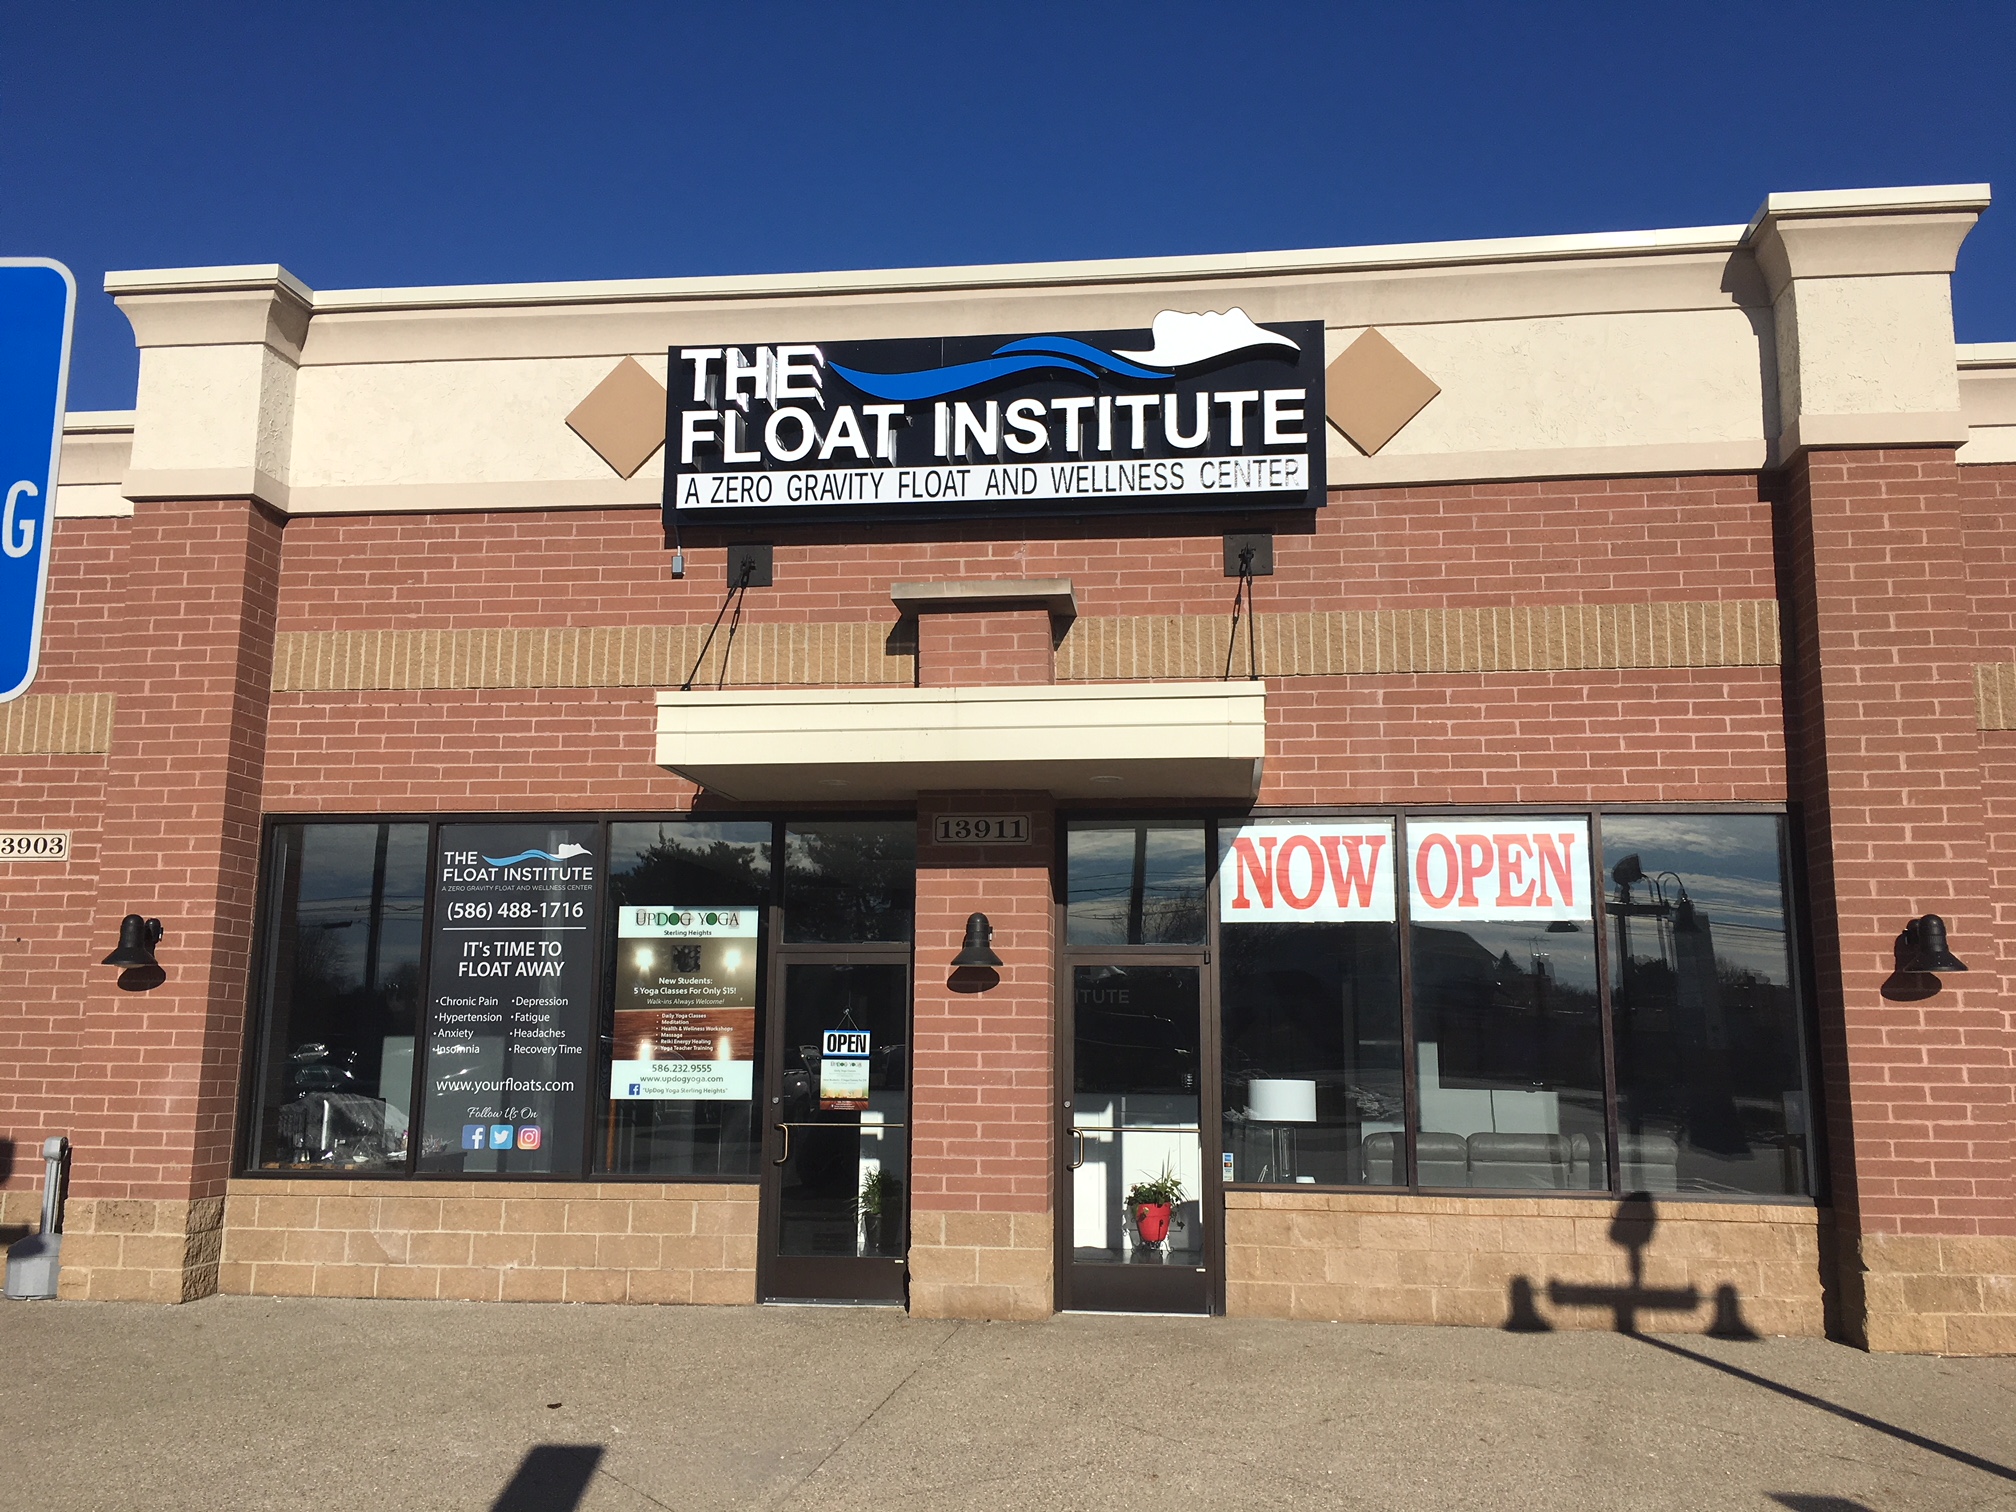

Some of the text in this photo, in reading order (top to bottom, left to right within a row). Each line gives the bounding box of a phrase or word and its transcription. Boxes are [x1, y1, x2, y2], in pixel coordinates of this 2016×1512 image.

[681, 345, 820, 401] THE
[681, 389, 1308, 464] FLOAT INSTITUTE
[684, 459, 1299, 504] A ZERO GRAVITY FLOAT AND WELLNESS CENTER
[2, 479, 39, 558] G
[939, 819, 1025, 838] 13911
[1, 837, 63, 854] 3903
[444, 851, 478, 865] THE
[443, 867, 593, 881] FLOAT INSTITUTE
[1231, 833, 1575, 910] NOW OPEN
[447, 902, 584, 921] (586) 488-1716
[635, 911, 740, 927] UPDOG YOGA
[688, 929, 712, 937] Heights
[463, 941, 562, 957] IT's TIME TO
[458, 961, 565, 977] FLOAT AWAY
[658, 977, 713, 985] New Students:
[640, 987, 659, 996] Yoga
[660, 987, 688, 995] Classes
[689, 987, 701, 995] For
[703, 987, 721, 996] Only
[722, 987, 737, 995] $15!
[440, 996, 498, 1006] Chronic Pain
[515, 997, 569, 1008] Depression
[673, 998, 695, 1006] Always
[439, 1013, 502, 1024] Hypertension
[514, 1013, 550, 1024] Fatigue
[437, 1029, 474, 1040] Anxiety
[513, 1028, 566, 1038] Headaches
[513, 1044, 582, 1056] Recovery Time
[827, 1033, 867, 1053] OPEN
[651, 1064, 712, 1073] 586.232.9555
[436, 1078, 574, 1094] www.yourfloats.com
[640, 1075, 724, 1084] www.updogyoga.com
[467, 1107, 502, 1118] Follow
[520, 1107, 538, 1119] On
